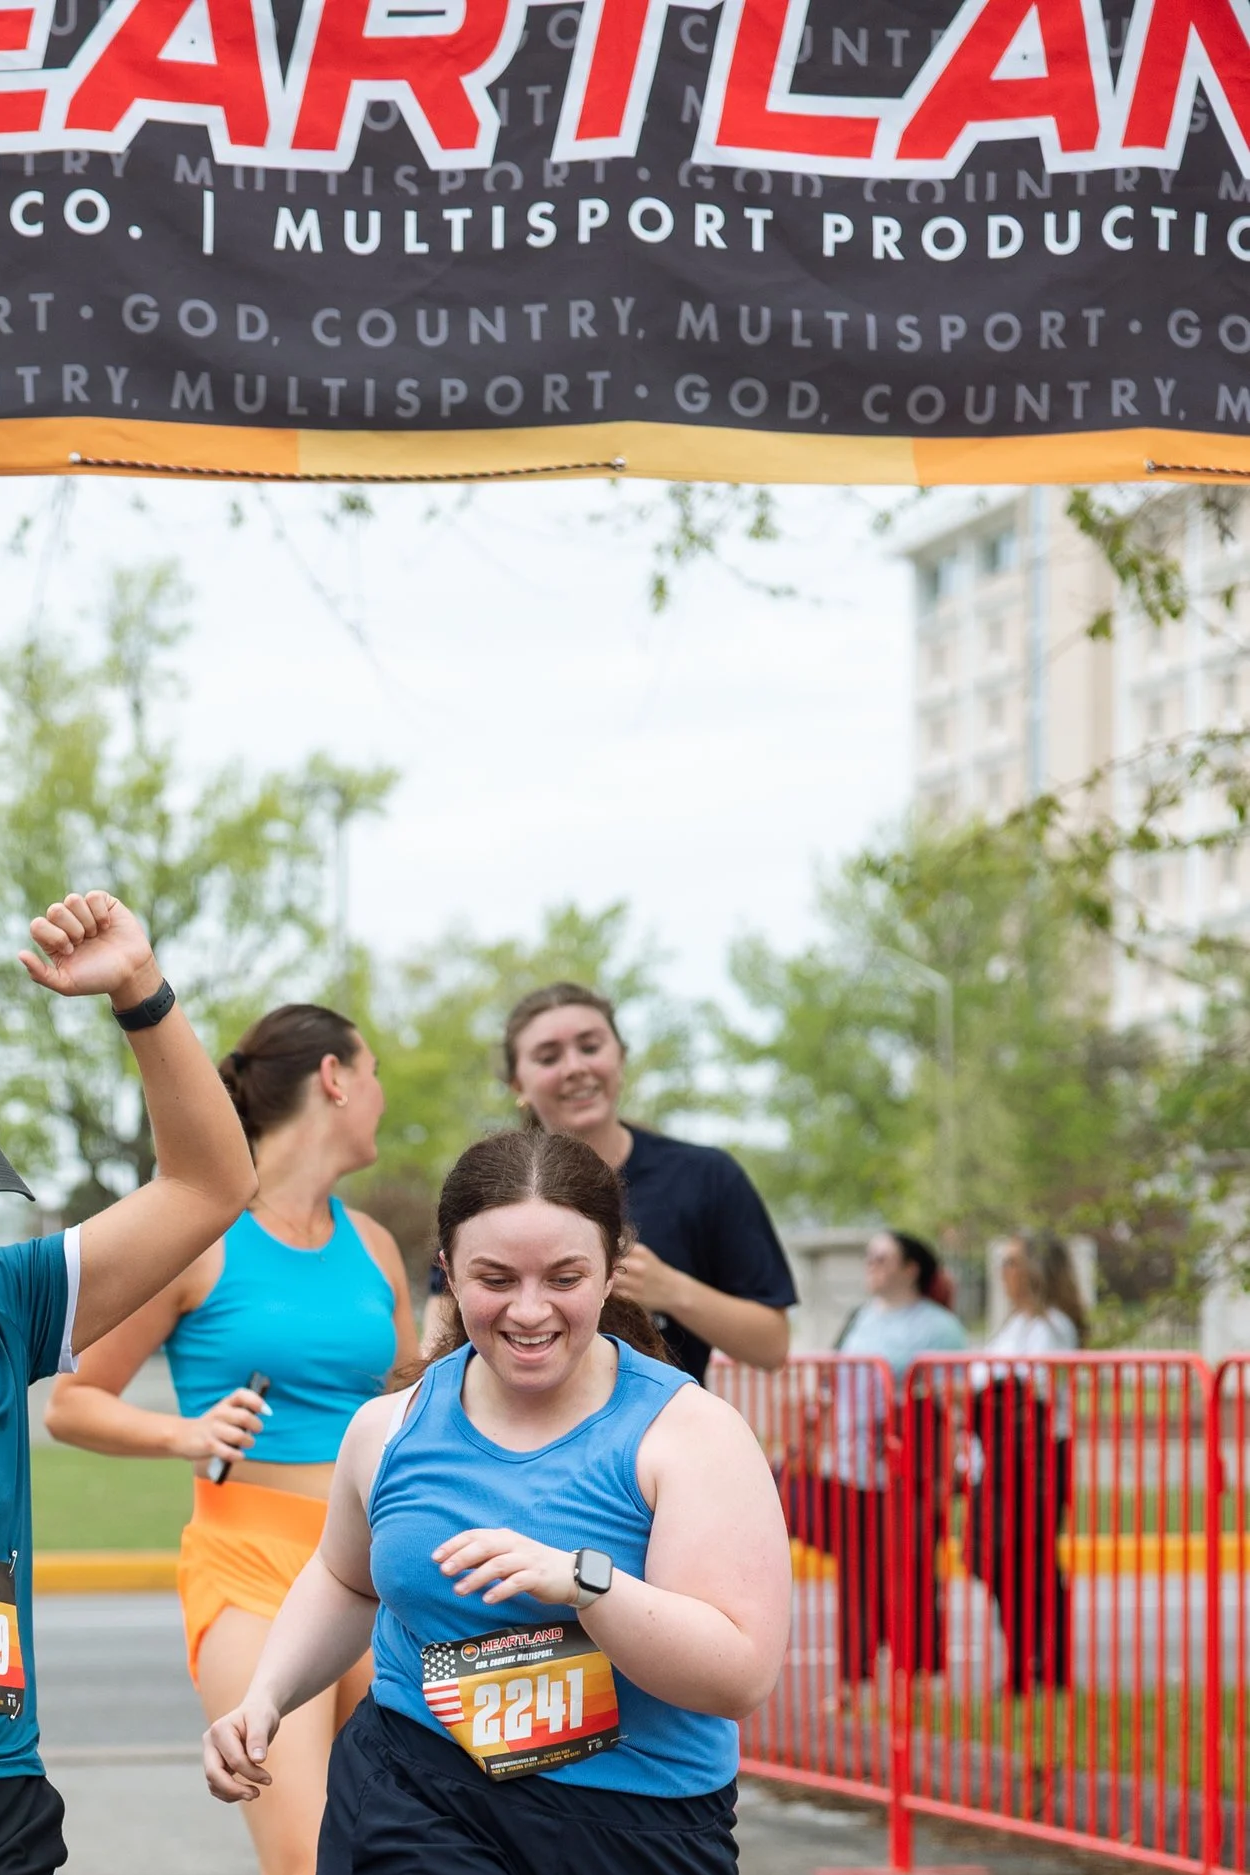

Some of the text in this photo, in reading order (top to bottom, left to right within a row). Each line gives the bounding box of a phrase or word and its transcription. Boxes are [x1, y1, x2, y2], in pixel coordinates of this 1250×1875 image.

[10, 188, 143, 241] CO.
[273, 197, 774, 255] MULTISPORT
[121, 293, 281, 347] GOD,
[311, 296, 646, 348] COUNTRY,
[676, 300, 1106, 353] MULTISPORT
[170, 369, 611, 418] MULTISPORT
[674, 373, 829, 424] GOD,
[862, 377, 1186, 425] COUNTRY,
[481, 1627, 563, 1653] HEARTLAND
[472, 1667, 584, 1747] 2241
